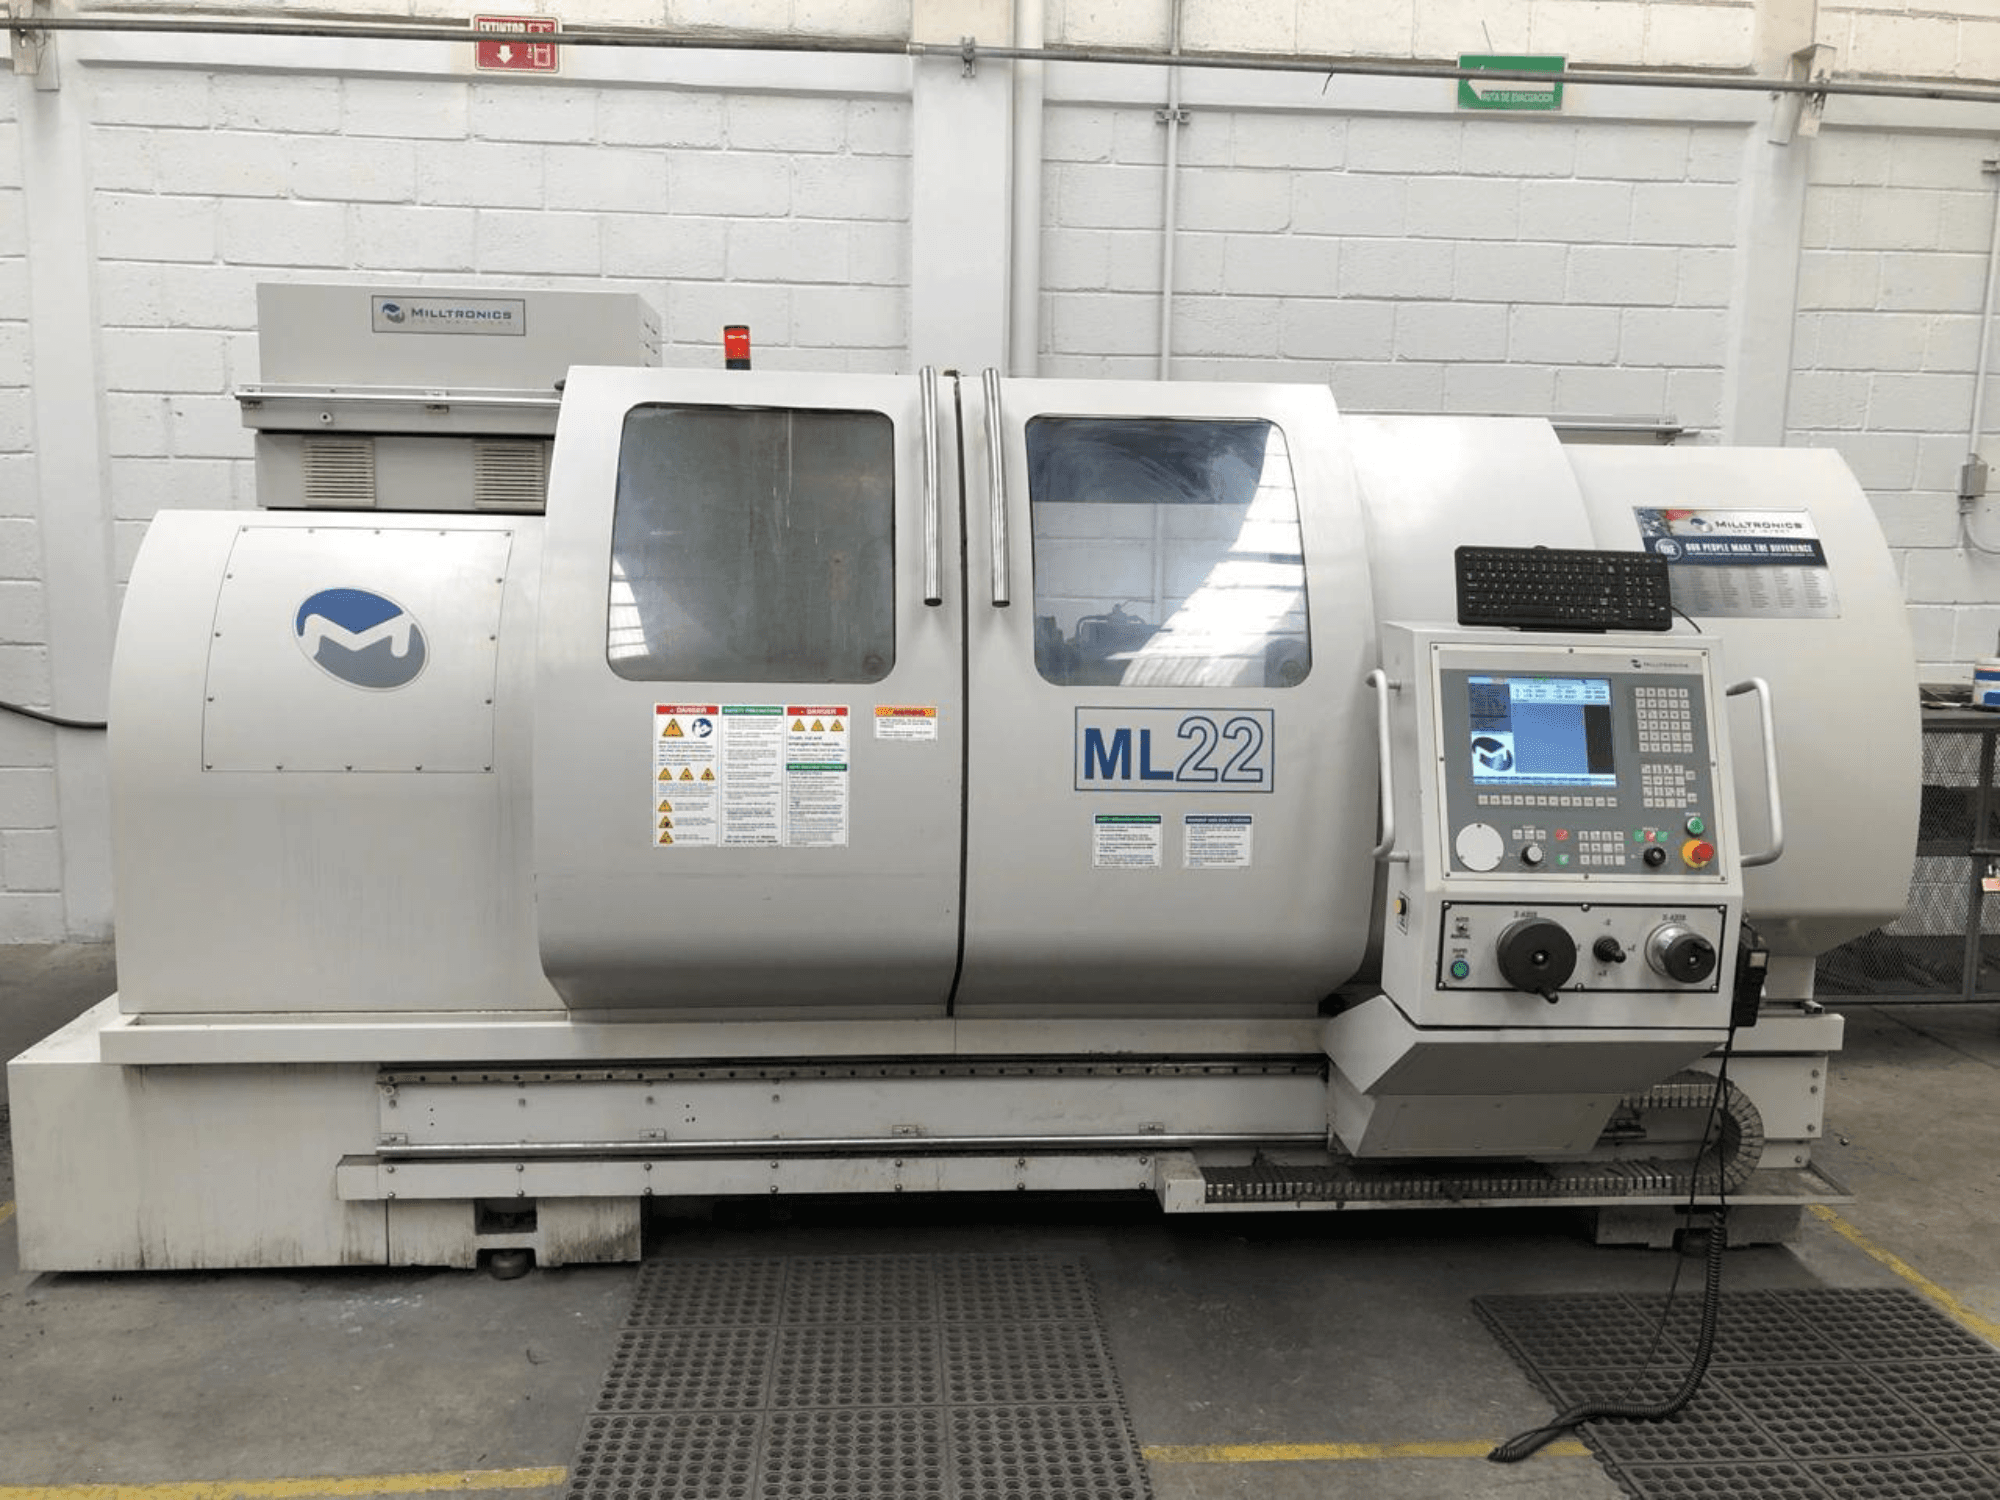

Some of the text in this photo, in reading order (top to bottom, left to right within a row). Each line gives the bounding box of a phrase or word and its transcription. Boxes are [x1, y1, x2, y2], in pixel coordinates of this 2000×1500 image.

[410, 308, 512, 320] MILLTRONICS
[1715, 520, 1803, 529] MILLTRONICS
[1703, 543, 1730, 552] PEOPLE
[1731, 543, 1753, 552] MAKE
[1084, 716, 1264, 783] ML22
